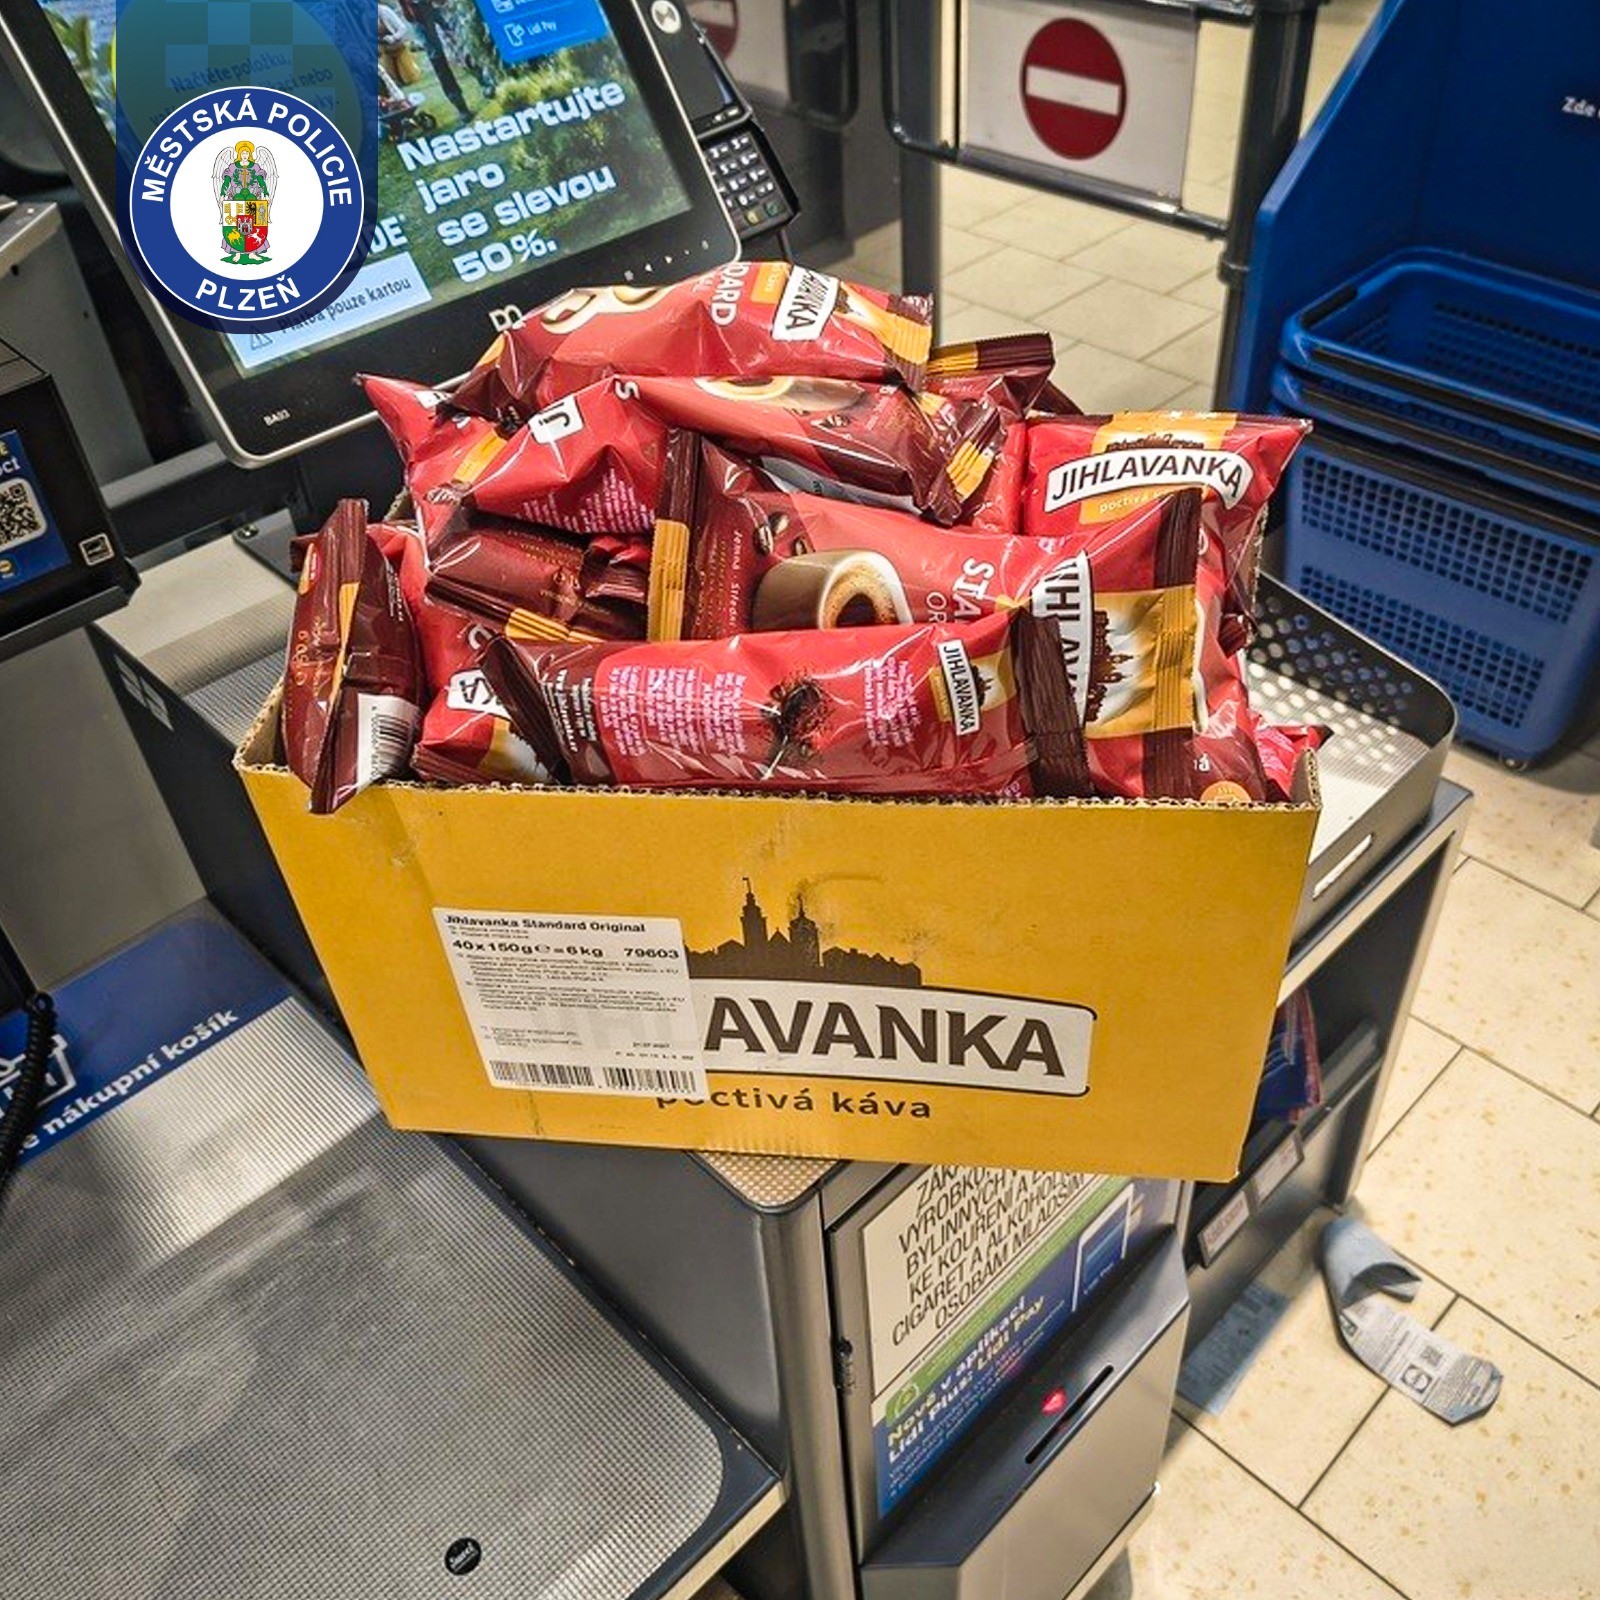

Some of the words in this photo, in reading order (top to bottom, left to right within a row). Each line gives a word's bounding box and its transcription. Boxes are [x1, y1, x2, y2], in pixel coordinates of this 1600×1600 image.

[397, 80, 625, 171] Nastartujte
[415, 163, 505, 213] jaro
[437, 210, 488, 247] se
[495, 164, 617, 228] slevou
[327, 294, 366, 321] pouze
[366, 277, 412, 303] kartou
[711, 264, 751, 327] DARD
[1052, 455, 1243, 501] JIHLAVANKA
[953, 557, 996, 622] STA
[943, 645, 975, 733] JIHLAVANKA
[444, 914, 519, 928] Jihlavanka
[522, 919, 587, 931] Standard
[591, 920, 646, 933] Original
[623, 947, 680, 959] 79603
[42, 1053, 162, 1134] nákupní
[160, 1009, 239, 1061] košík
[703, 996, 1066, 1077] AVANKA
[832, 1092, 931, 1119] káva
[909, 1271, 932, 1304] KE
[1017, 1180, 1028, 1201] A
[891, 1261, 966, 1347] CIGARET
[969, 1248, 984, 1272] A
[888, 1420, 925, 1464] Lidl
[977, 1330, 1010, 1370] Lidl
[1013, 1295, 1045, 1332] Pay
[940, 1375, 952, 1390] v
[955, 1295, 1026, 1377] aplikaci
